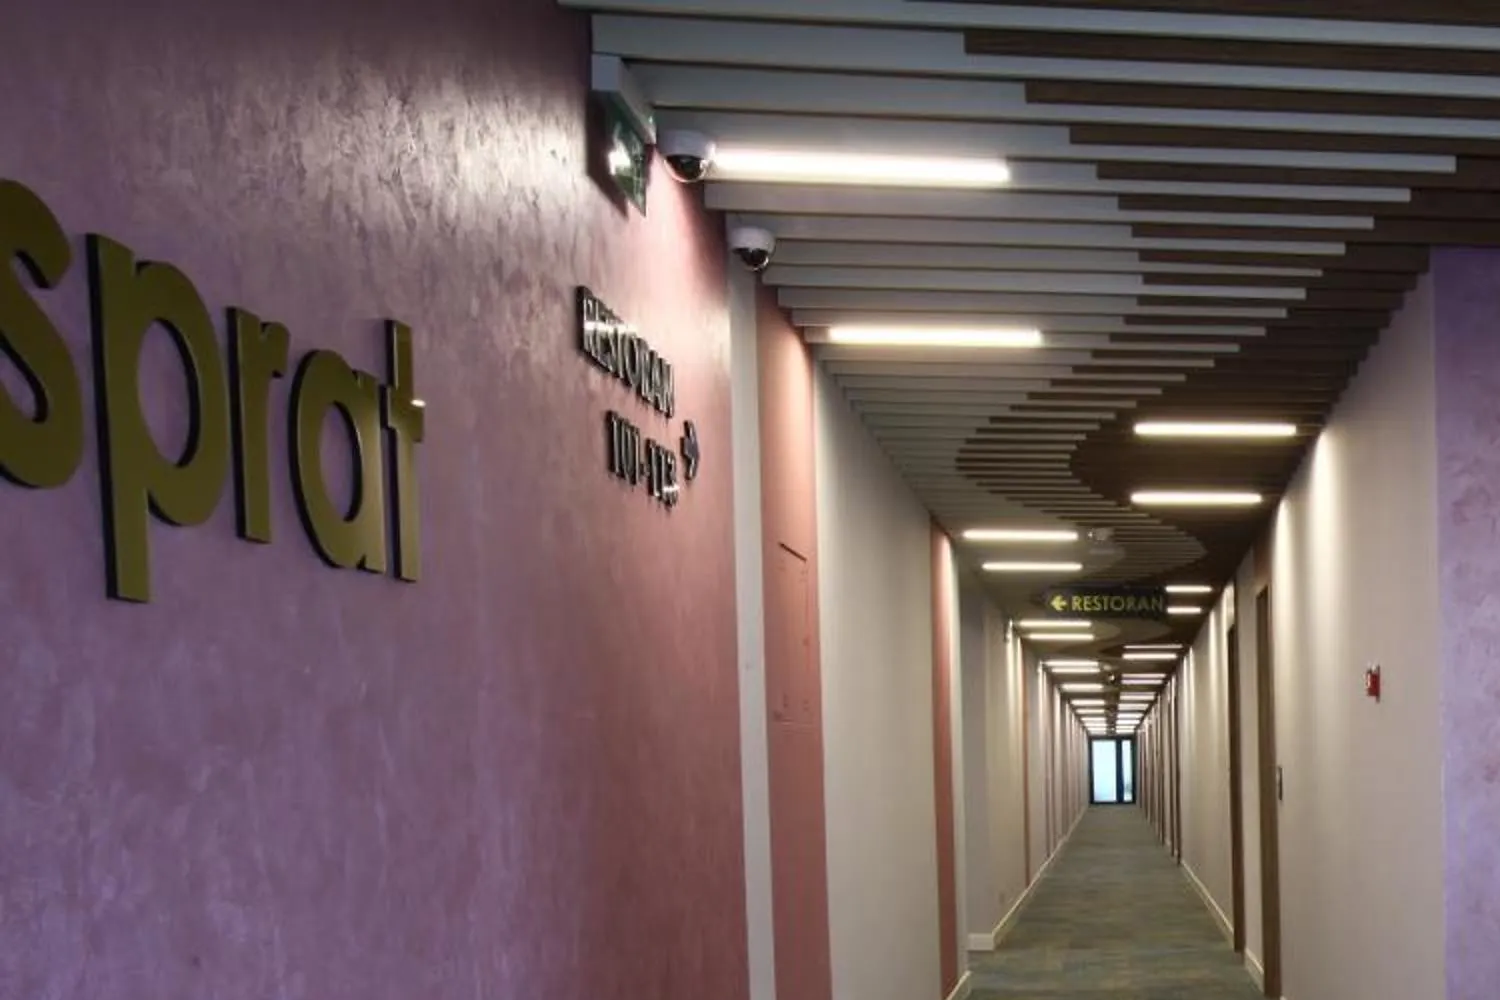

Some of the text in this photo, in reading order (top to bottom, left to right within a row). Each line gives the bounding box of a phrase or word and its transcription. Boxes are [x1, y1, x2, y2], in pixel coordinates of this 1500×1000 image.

[0, 178, 425, 603] sprat
[576, 285, 675, 418] RESTORAN
[1071, 595, 1163, 612] RESTORAN
